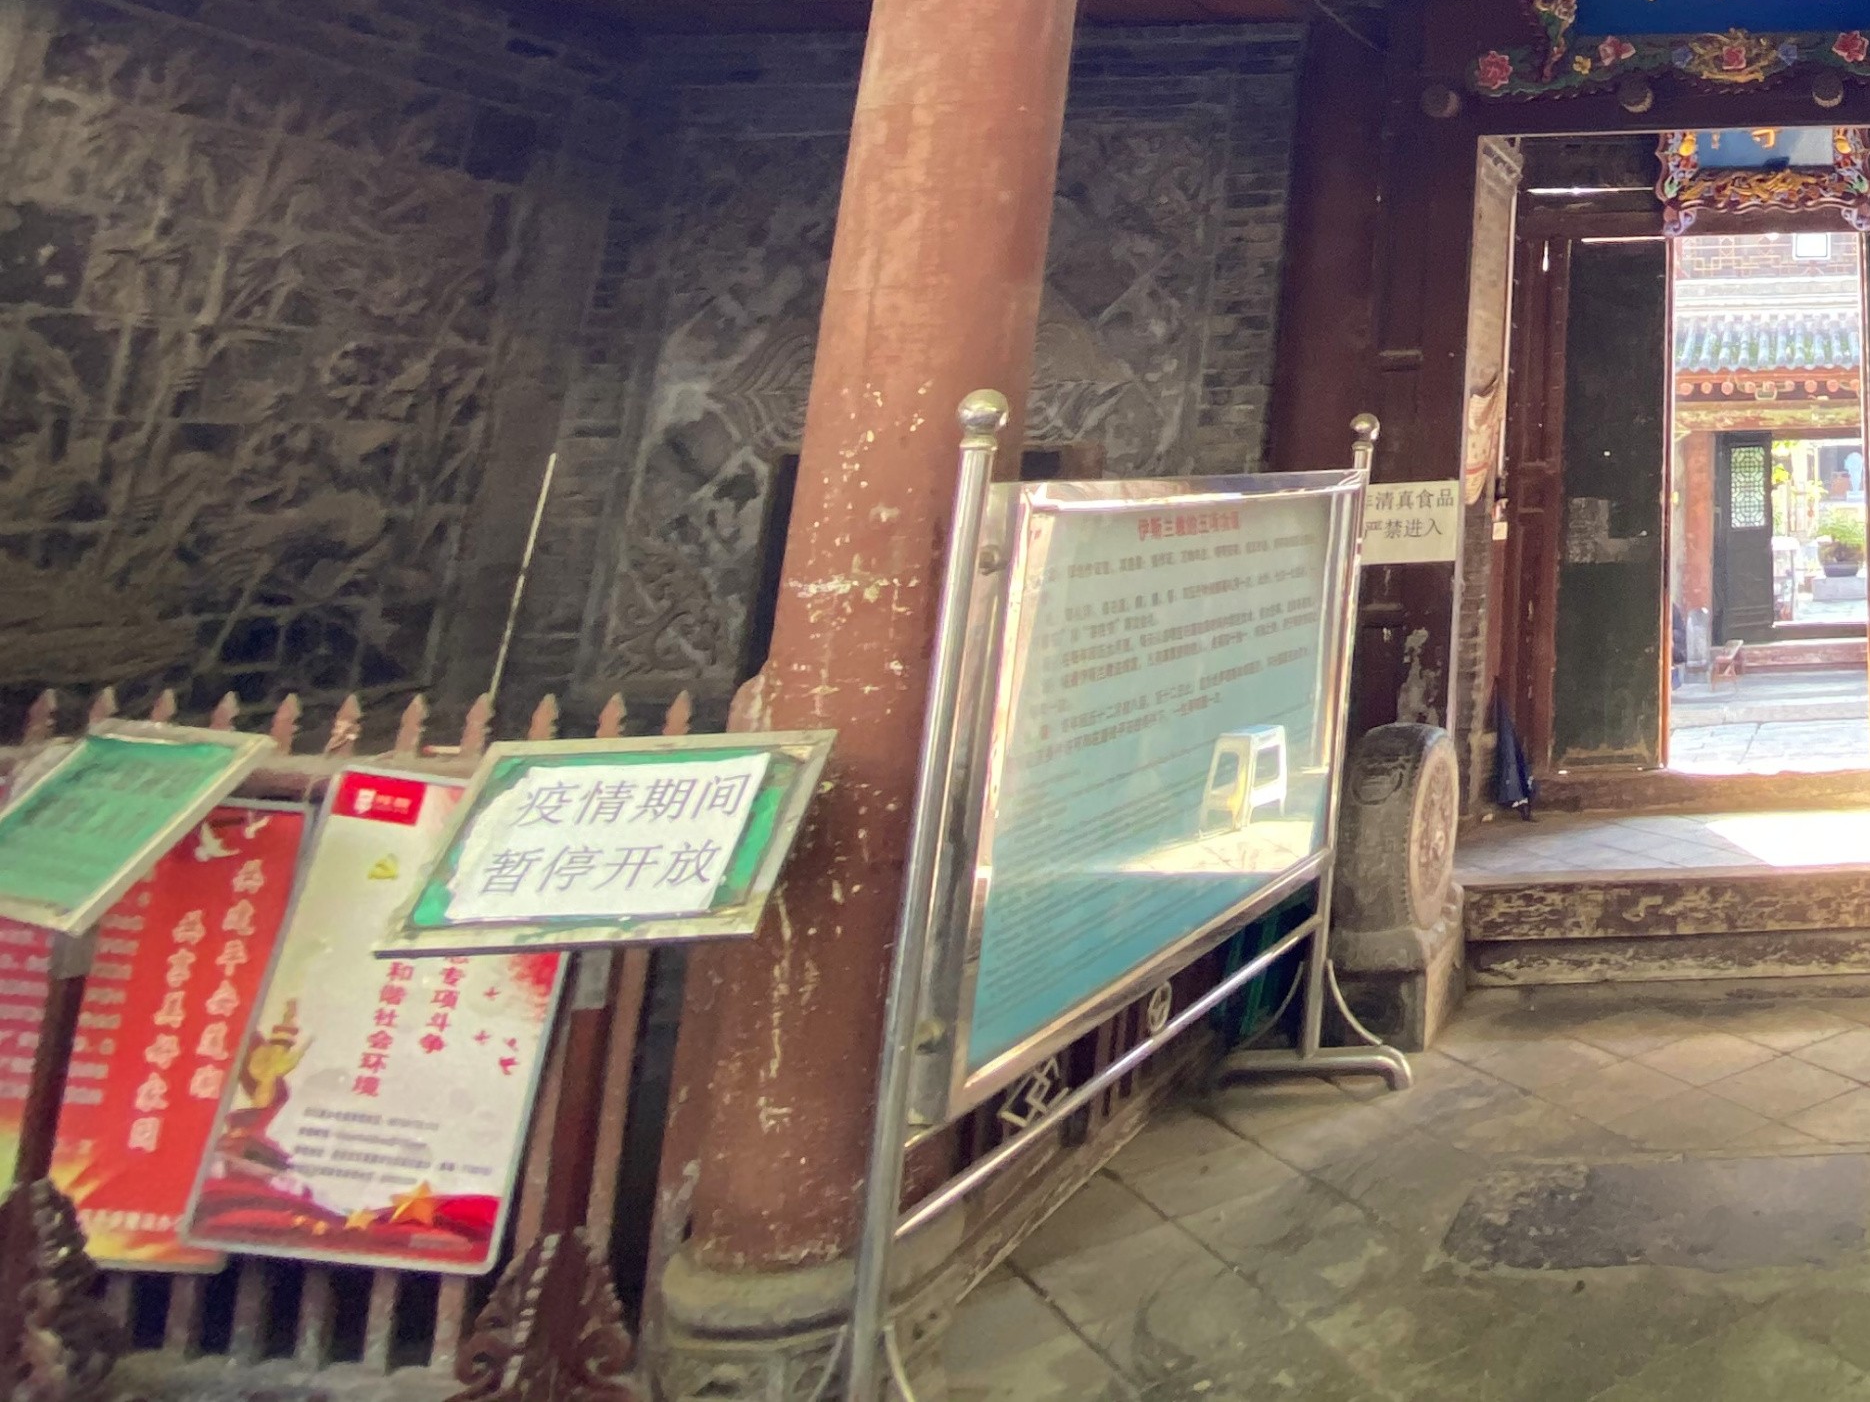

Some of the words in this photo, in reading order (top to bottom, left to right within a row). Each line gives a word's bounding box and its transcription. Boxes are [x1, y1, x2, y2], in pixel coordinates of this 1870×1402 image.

[1364, 518, 1444, 539] 严禁进入
[508, 773, 752, 828] 疫情期间
[478, 838, 722, 895] 暂停开放
